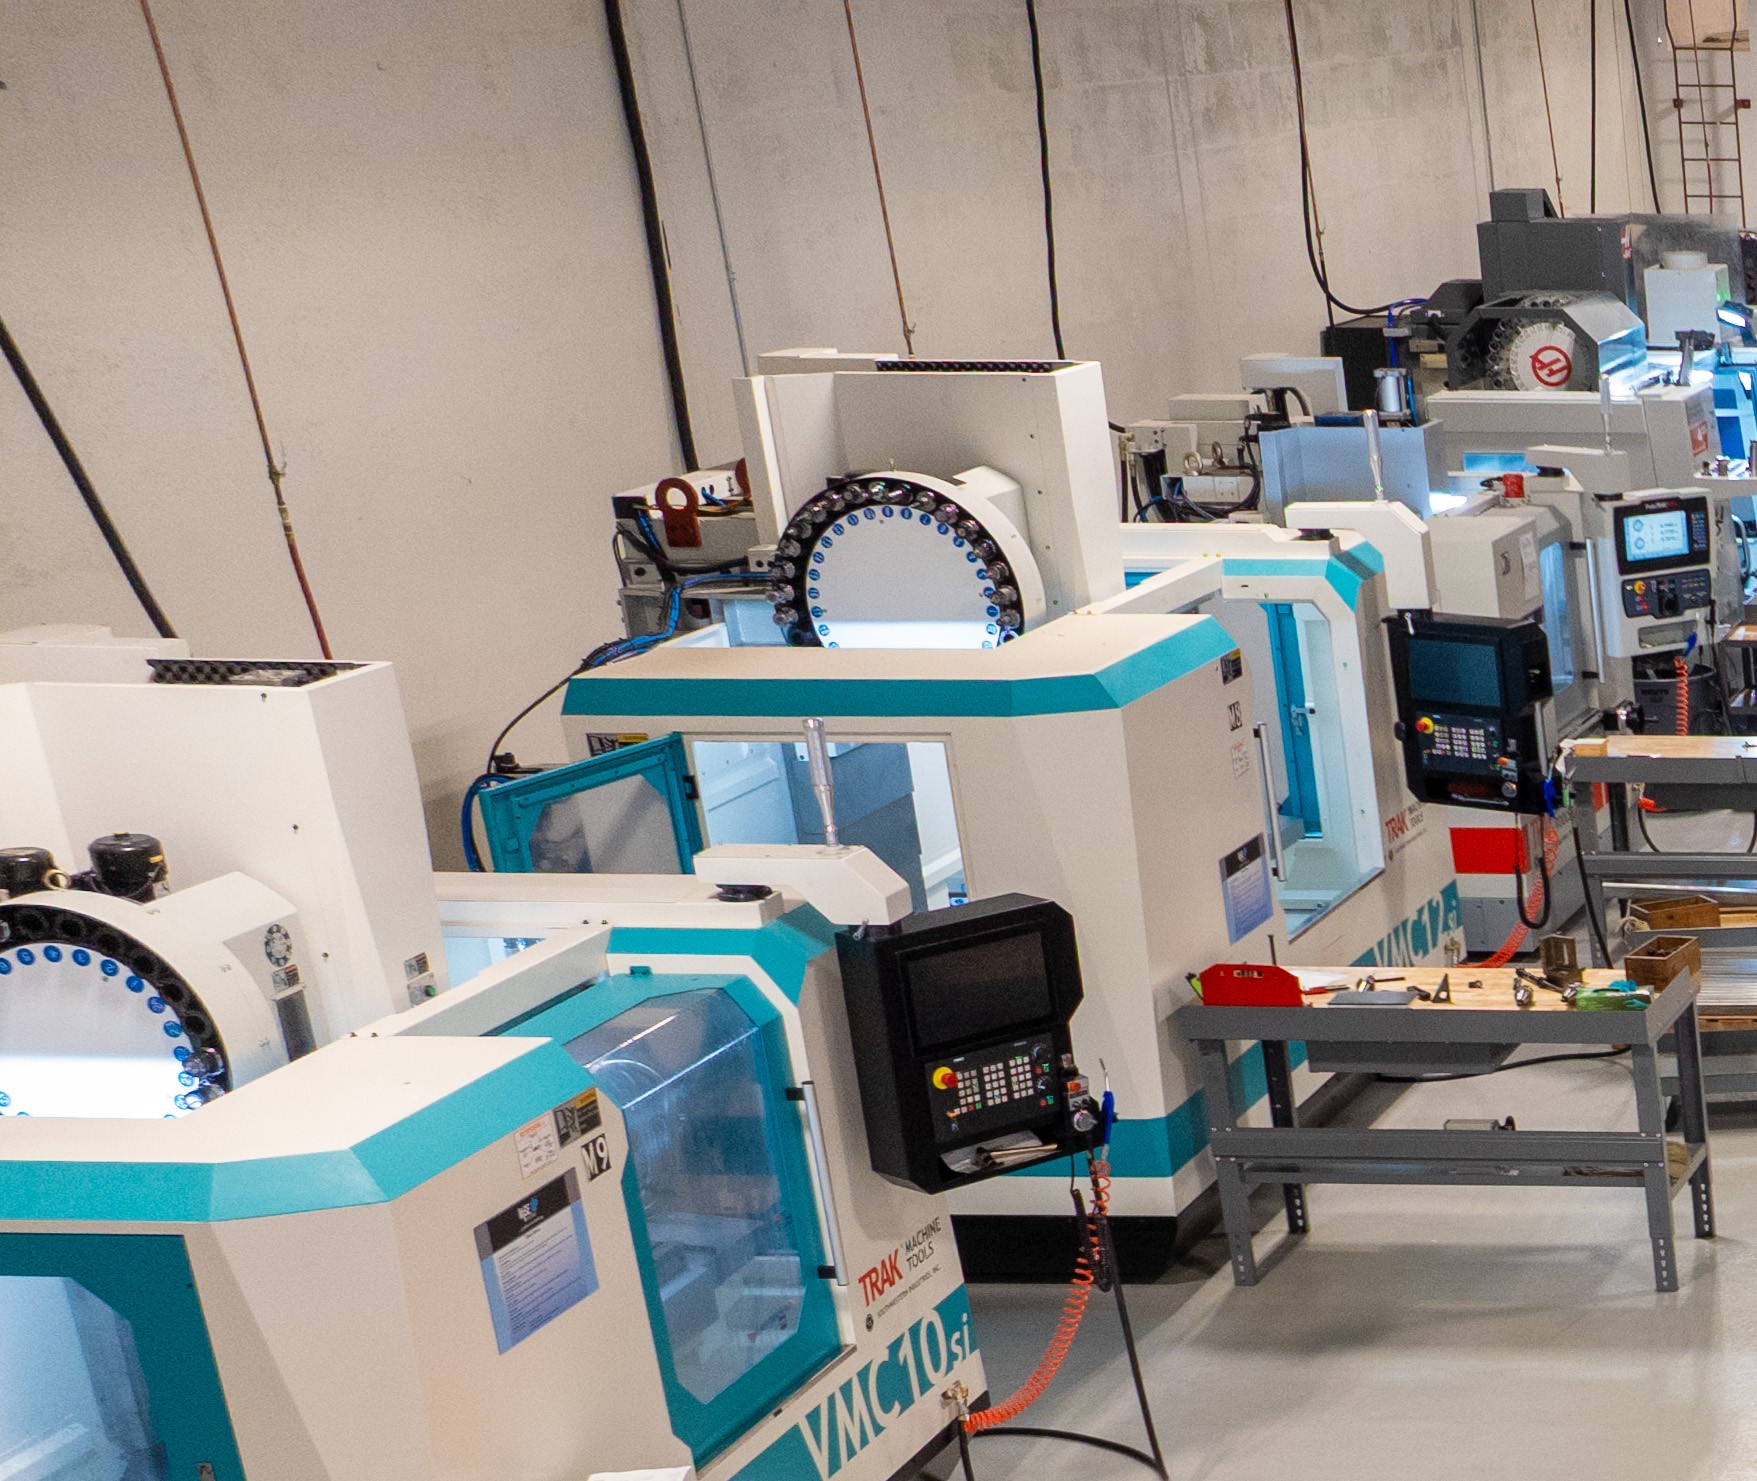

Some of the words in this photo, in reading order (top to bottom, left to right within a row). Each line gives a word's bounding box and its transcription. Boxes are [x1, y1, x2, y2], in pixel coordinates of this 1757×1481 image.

[582, 1133, 609, 1181] M9
[858, 1247, 904, 1307] TRAK
[904, 1216, 942, 1254] MACHINE
[907, 1240, 935, 1272] TOOLS
